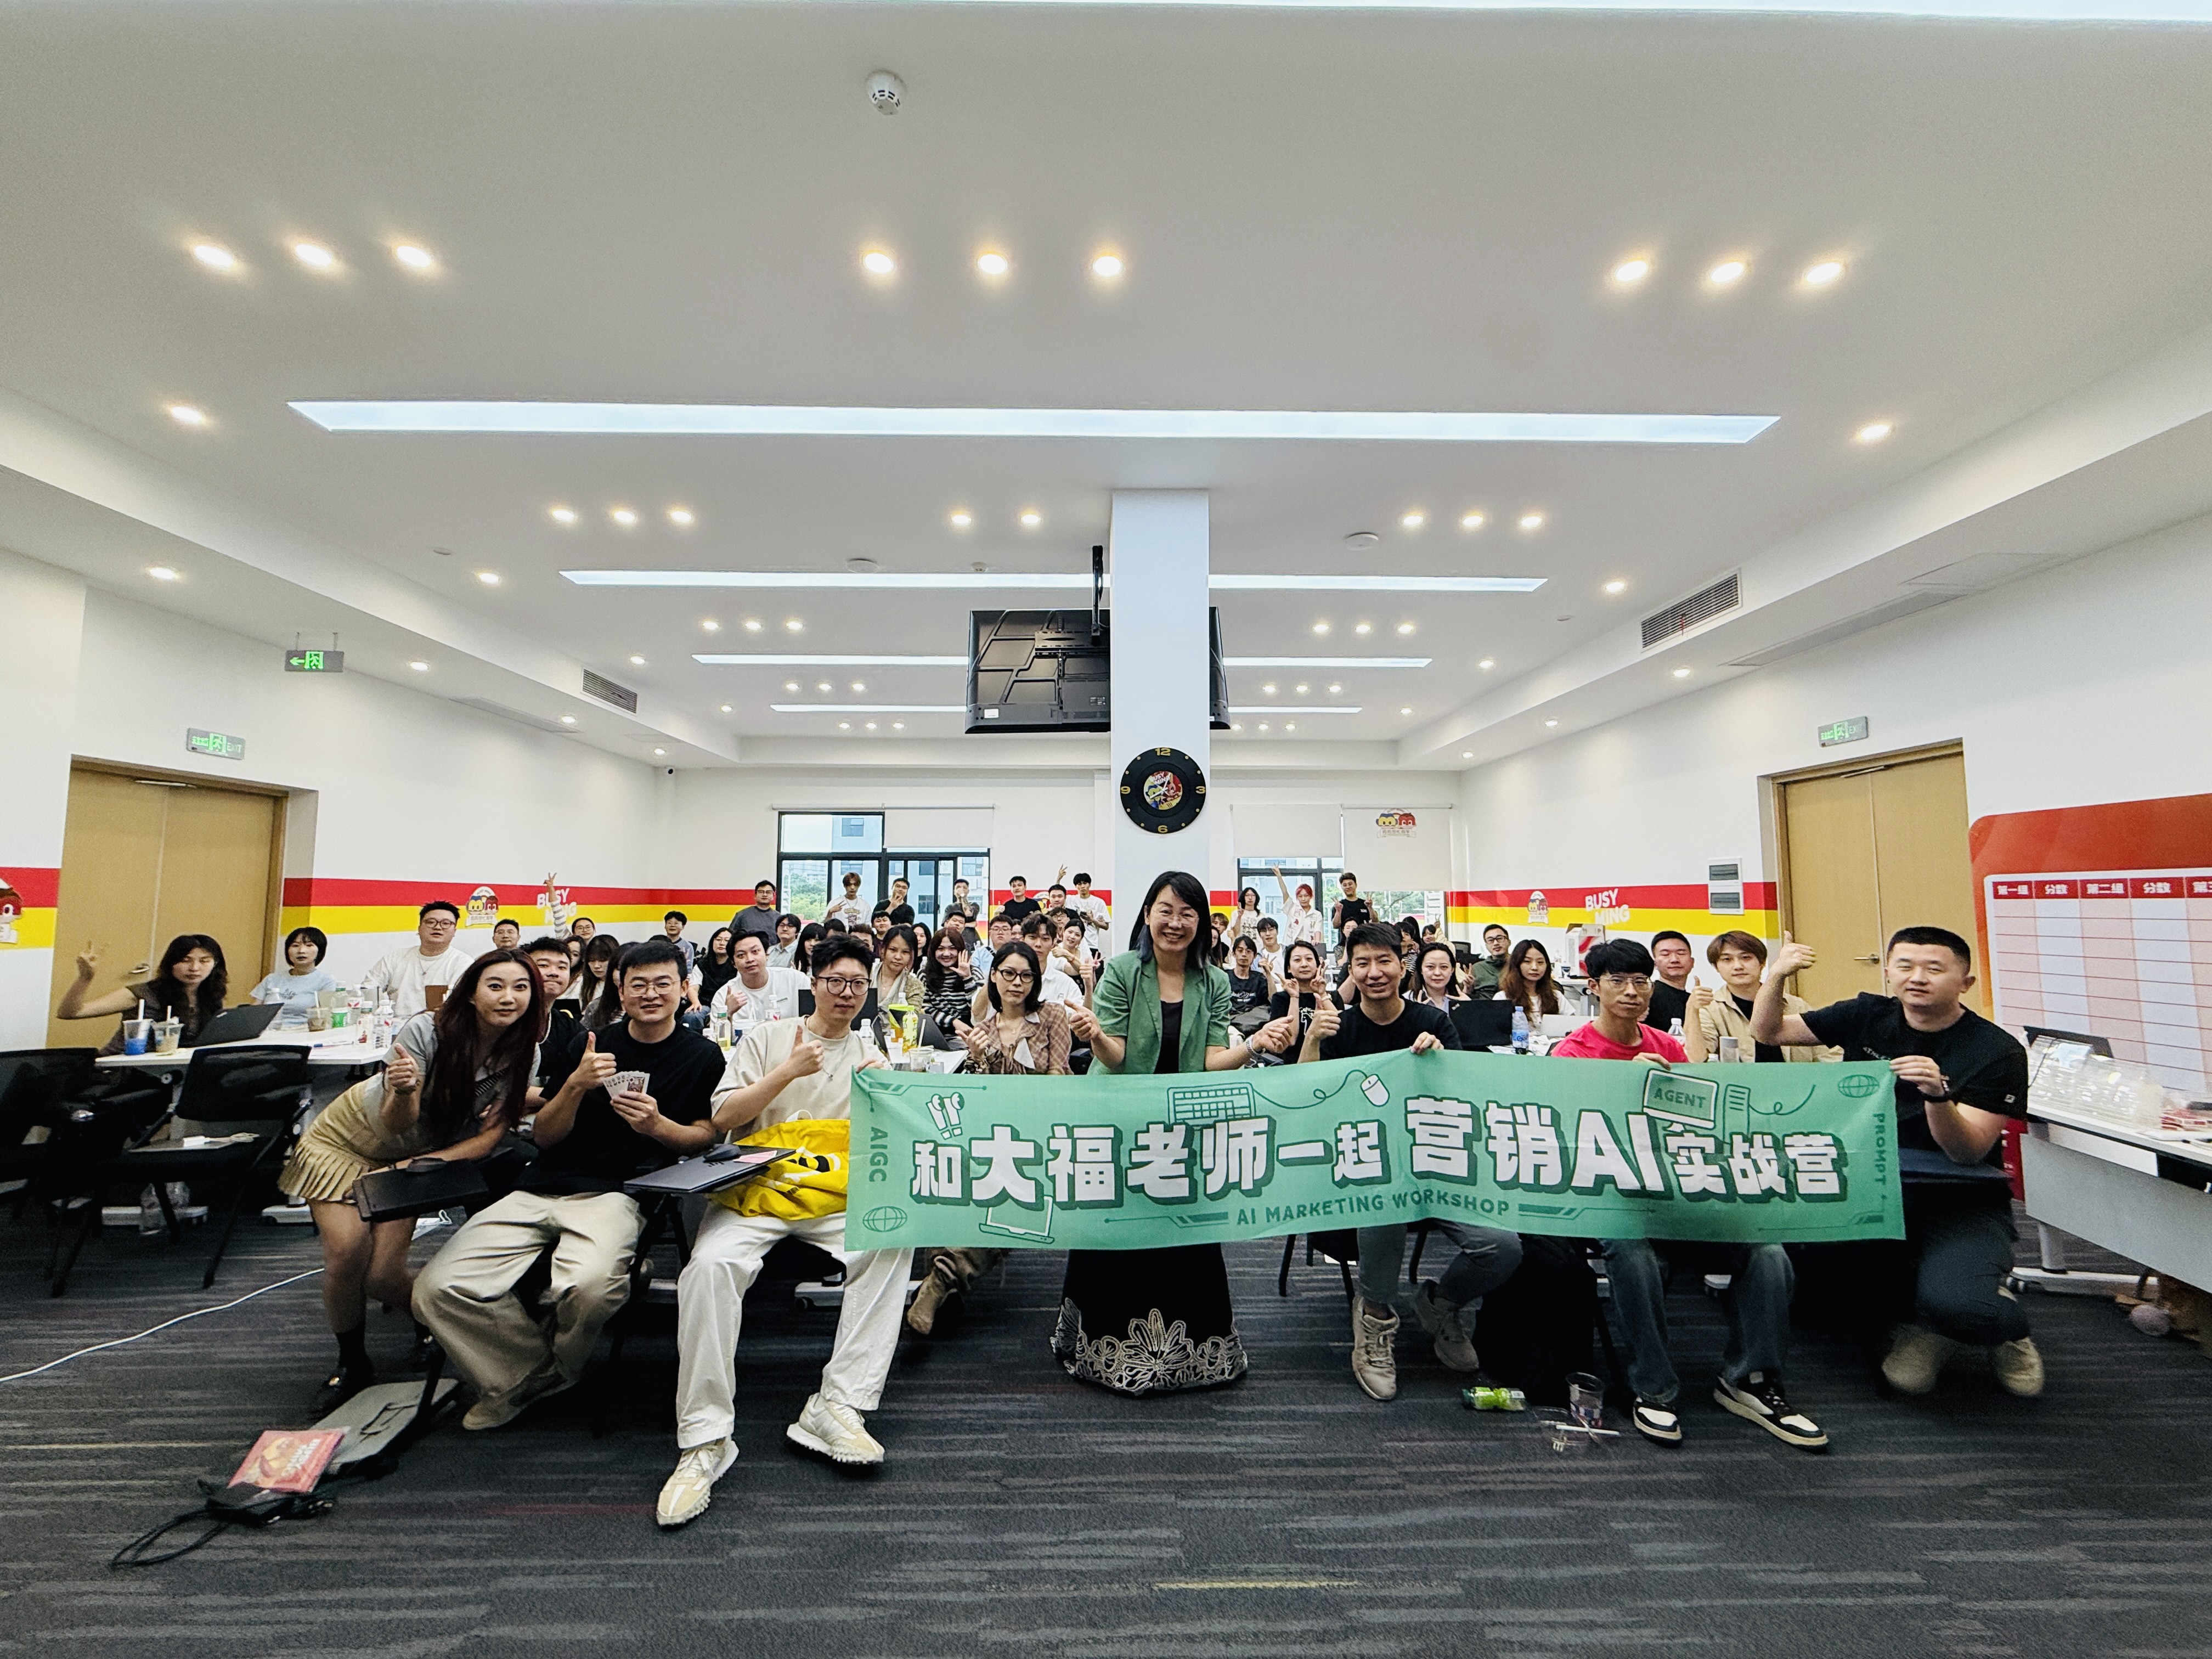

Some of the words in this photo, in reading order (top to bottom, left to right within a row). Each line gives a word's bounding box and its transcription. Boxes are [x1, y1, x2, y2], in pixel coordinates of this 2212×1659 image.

[1155, 747, 1171, 756] 12
[1120, 786, 1131, 794] 9
[1195, 786, 1206, 794] 3
[1158, 825, 1168, 833] 6
[2086, 883, 2124, 894] 第二组
[1585, 888, 1619, 912] BUSY
[1595, 904, 1630, 926] MING
[1654, 1087, 1706, 1108] AGENT
[868, 1126, 888, 1182] AIGC
[1872, 1113, 1887, 1185] PROMPT
[912, 1116, 1388, 1206] 和大福老师一起
[1237, 1207, 1256, 1225] AI
[1266, 1194, 1384, 1223] MARKETING
[1392, 1188, 1509, 1216] WORKSHOP
